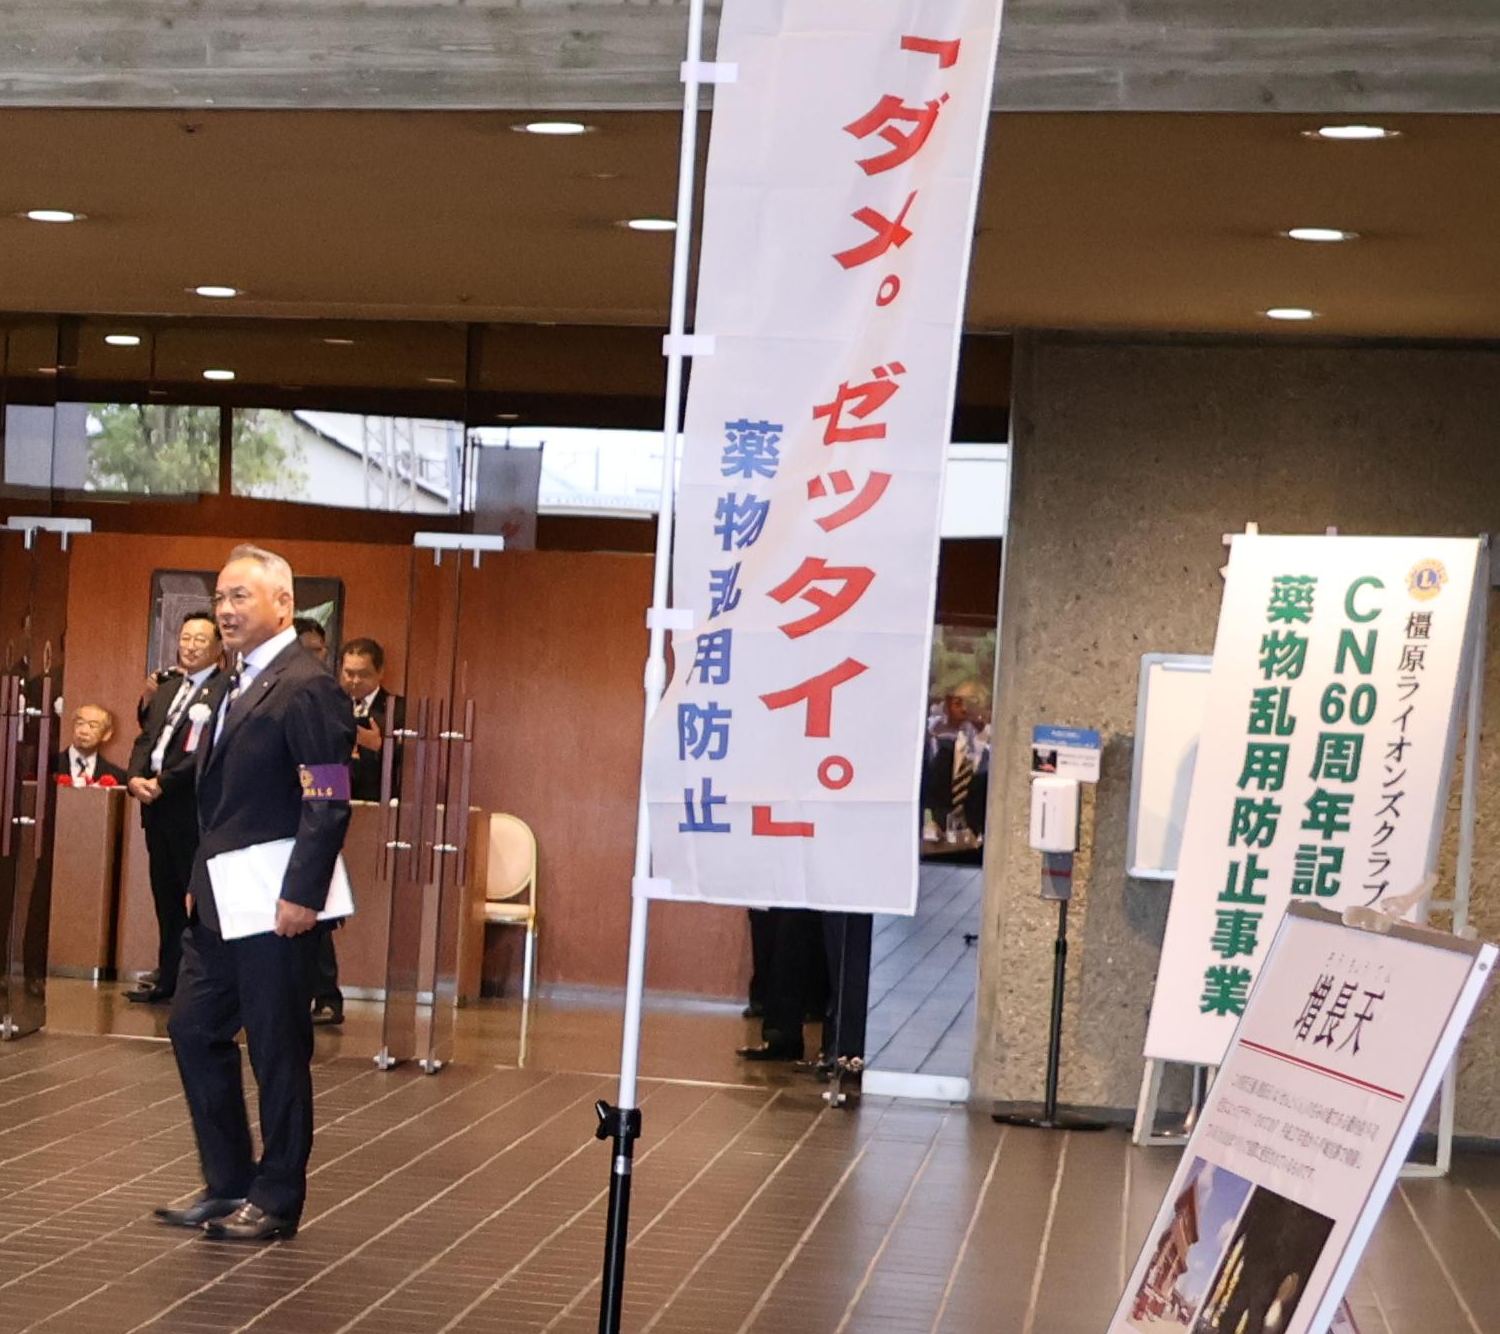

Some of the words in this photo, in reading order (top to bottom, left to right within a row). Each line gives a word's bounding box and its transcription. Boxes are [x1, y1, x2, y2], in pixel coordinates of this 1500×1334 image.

[678, 418, 784, 835] 薬物乱用防止
[1198, 574, 1319, 1017] 薬物乱用防止事業
[1289, 575, 1386, 907] CN60周年記
[1362, 610, 1434, 907] 橿原ライオンズクラブ
